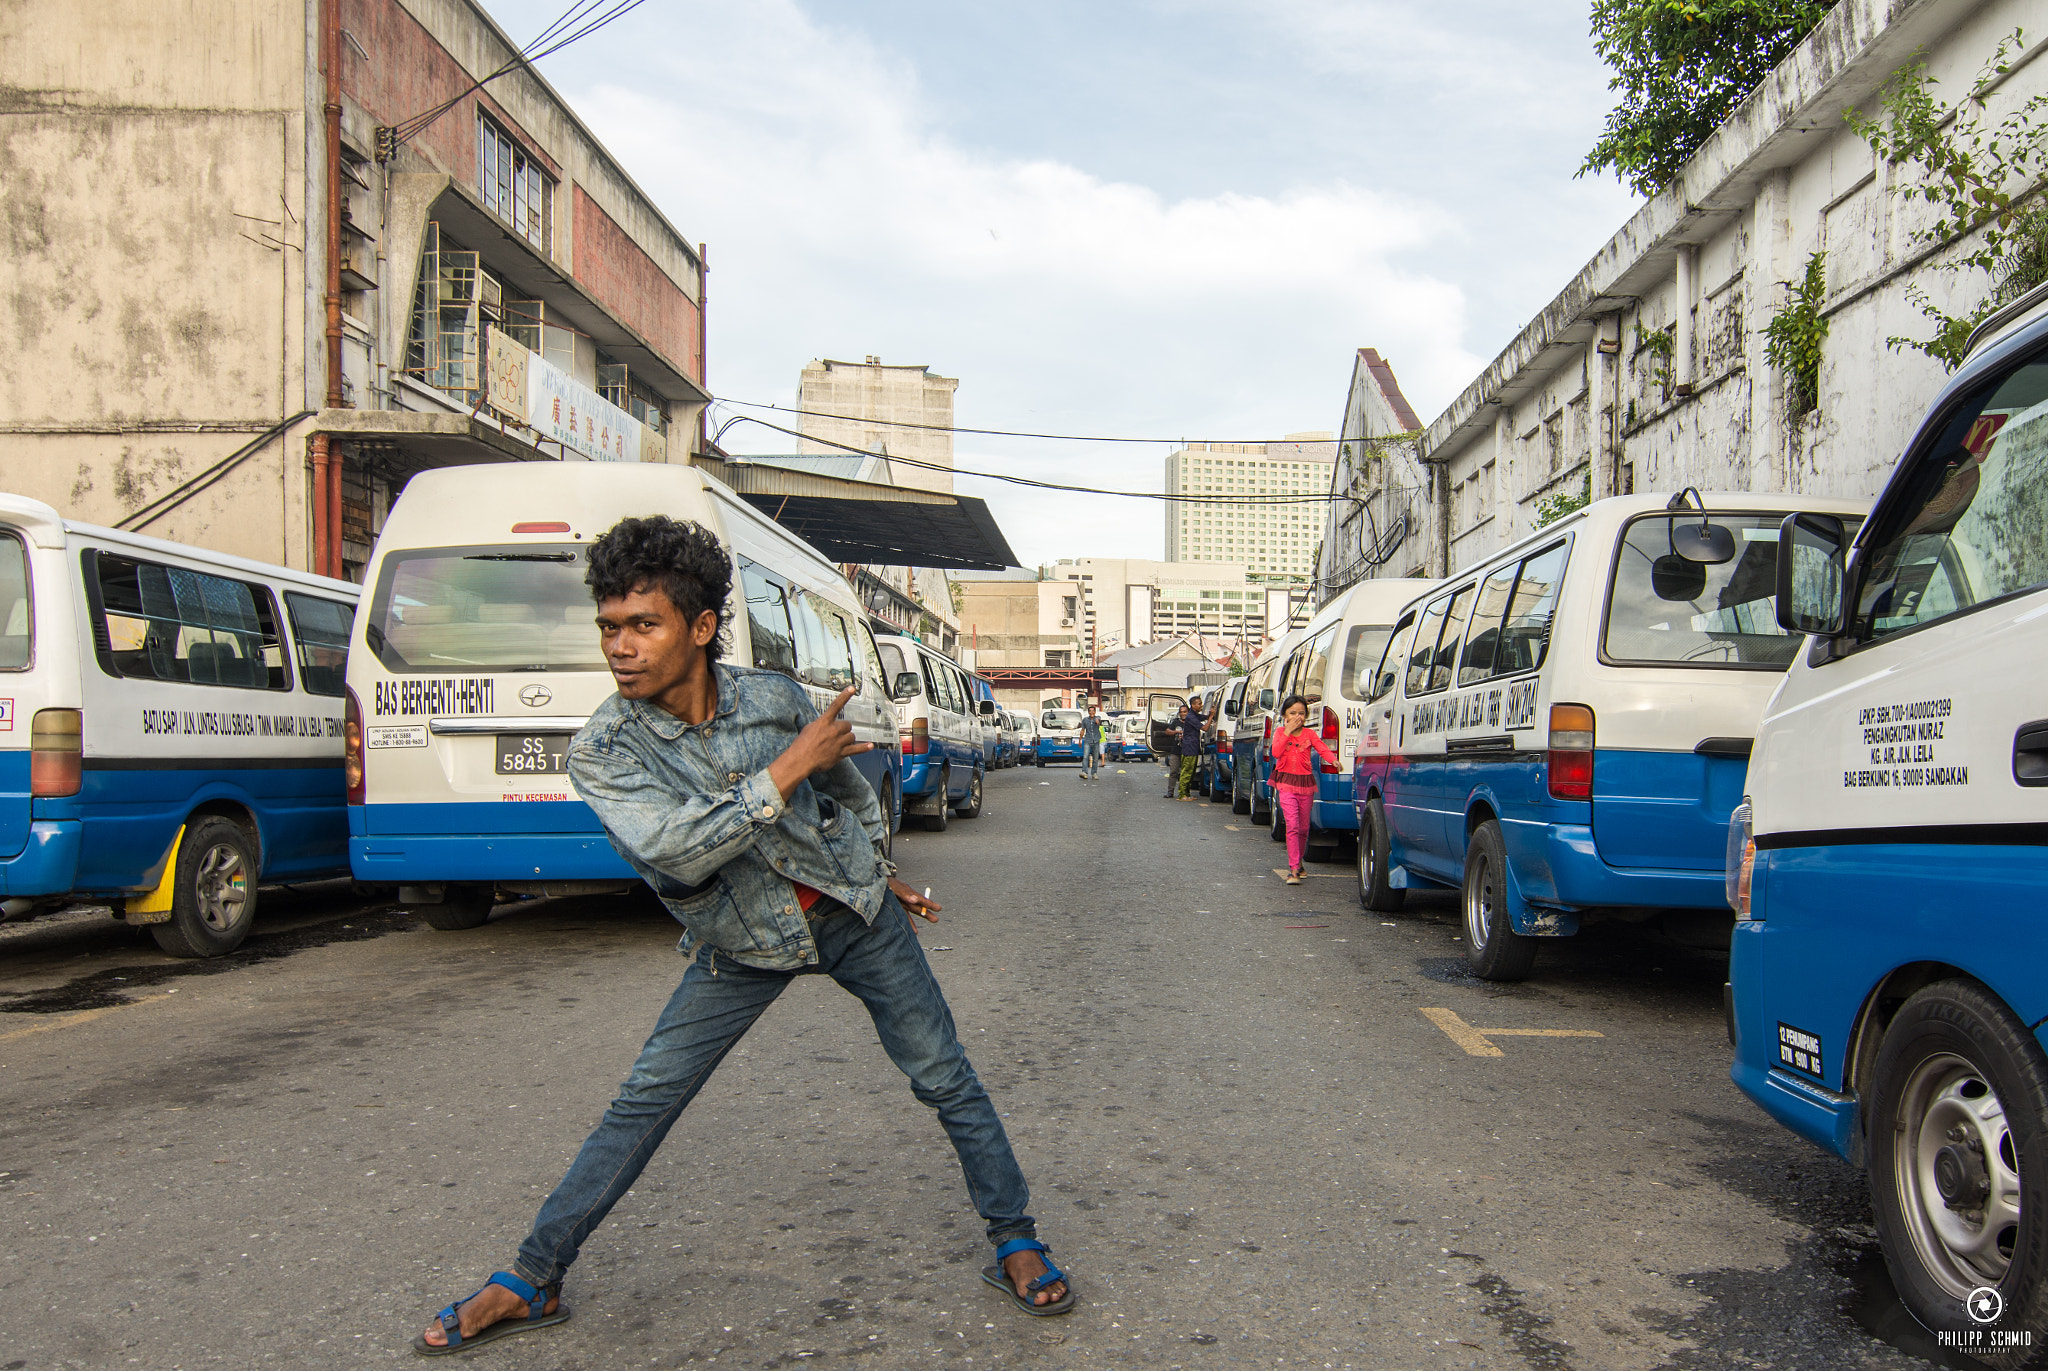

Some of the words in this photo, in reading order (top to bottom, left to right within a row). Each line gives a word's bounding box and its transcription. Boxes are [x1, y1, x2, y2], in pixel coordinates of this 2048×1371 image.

[1303, 443, 1333, 454] POINTS
[376, 682, 398, 715] BAS
[401, 679, 494, 714] BERHENTI-HENTI
[143, 709, 162, 734] BATU
[162, 709, 178, 734] SAPI
[197, 711, 218, 735] LINTAS
[218, 712, 231, 736] ULU
[231, 713, 255, 737] SIBUGA
[273, 715, 296, 737] MAWAR
[1346, 706, 1362, 730] BAS
[1863, 724, 1917, 745] PENGANGKUTAN
[1918, 721, 1944, 741] NURAZ
[522, 737, 544, 754] SS
[1913, 744, 1934, 763] LEILA
[503, 752, 547, 771] 5845
[552, 753, 562, 770] T
[1844, 771, 1857, 787] BAG
[1858, 769, 1890, 787] BERKUNCI
[1902, 768, 1924, 786] 90009
[1925, 766, 1968, 785] SANDAKAN
[502, 794, 524, 802] PINTU
[525, 793, 567, 802] KECEMASAN
[1780, 1026, 1786, 1042] 12
[1781, 1045, 1794, 1064] BTM
[1795, 1050, 1808, 1070] 1900
[1811, 1056, 1821, 1074] KG
